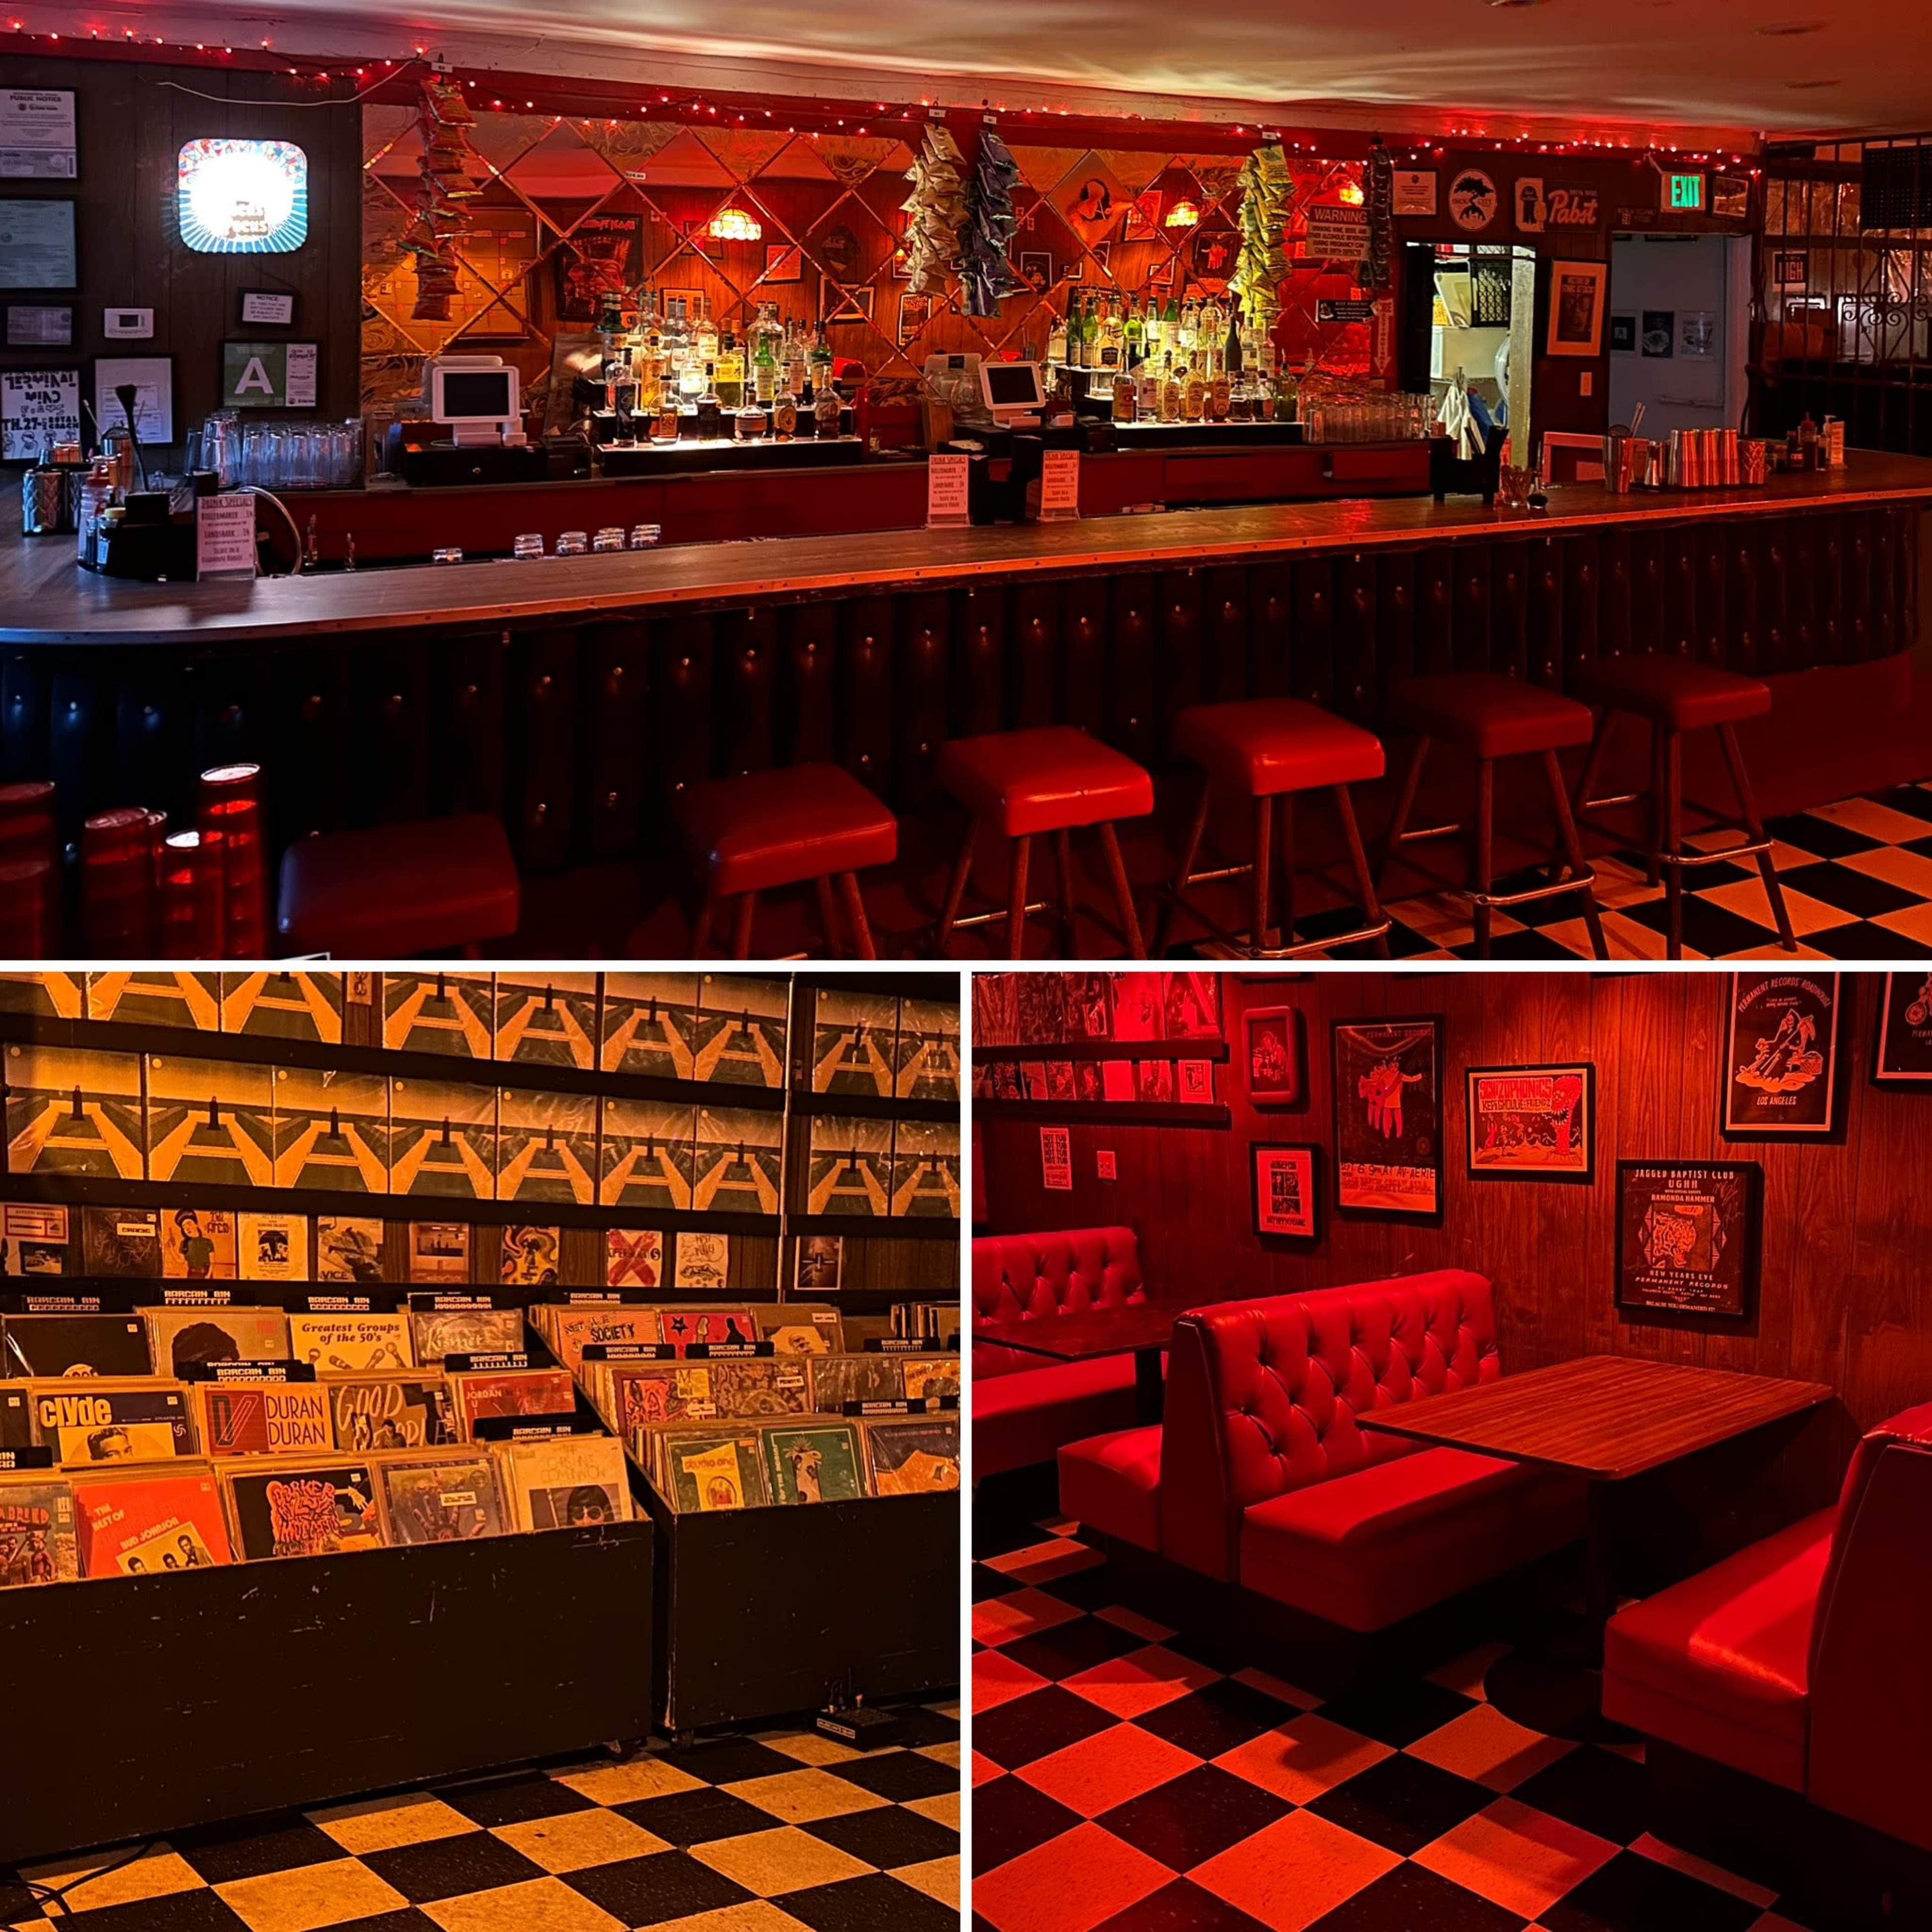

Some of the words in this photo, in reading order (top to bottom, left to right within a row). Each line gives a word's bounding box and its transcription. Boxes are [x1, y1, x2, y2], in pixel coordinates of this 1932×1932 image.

[1671, 176, 1701, 207] EXIT
[1548, 189, 1598, 225] Pabst
[1314, 208, 1367, 223] WARNING
[234, 357, 274, 394] A
[1738, 981, 1769, 1013] PERMANENT
[1801, 979, 1832, 1008] ROADHOUSE
[1479, 1077, 1553, 1099] SCHIZOPHONICS
[1756, 1096, 1768, 1105] LOS
[1769, 1096, 1797, 1105] ANGELES
[1043, 1134, 1053, 1142] HOT
[1056, 1134, 1068, 1142] TUB
[1045, 1157, 1055, 1165] HOT
[1058, 1157, 1068, 1165] TUB
[1635, 1169, 1667, 1178] JAGGED
[1671, 1170, 1707, 1179] BAPTIST
[1712, 1171, 1734, 1179] CLUB
[1668, 1180, 1698, 1189] UGHH
[1651, 1194, 1684, 1202] RAMONDA
[1685, 1195, 1715, 1203] HAMMER
[322, 1270, 348, 1280] VICE
[1669, 1271, 1695, 1279] YEARS
[1635, 1276, 1684, 1285] PERMANENT
[1688, 1281, 1729, 1290] RECORDS
[302, 1323, 353, 1332] Greatest
[357, 1323, 400, 1334] Groups
[591, 1323, 634, 1343] SOCIETY
[319, 1334, 333, 1345] of
[337, 1333, 355, 1342] the
[359, 1333, 382, 1343] 50's
[422, 1327, 484, 1358] Kismet
[466, 1389, 502, 1400] JORDAN
[39, 1396, 112, 1428] clyde
[266, 1396, 324, 1419] DURAN
[337, 1384, 404, 1431] GOOD
[268, 1421, 326, 1445] DURAN
[685, 1459, 715, 1471] studio
[716, 1457, 735, 1466] one
[93, 1503, 112, 1516] THE
[91, 1515, 113, 1532] BEST
[112, 1509, 125, 1522] OF
[120, 1535, 139, 1550] BUD
[140, 1516, 180, 1542] JOHNSON
